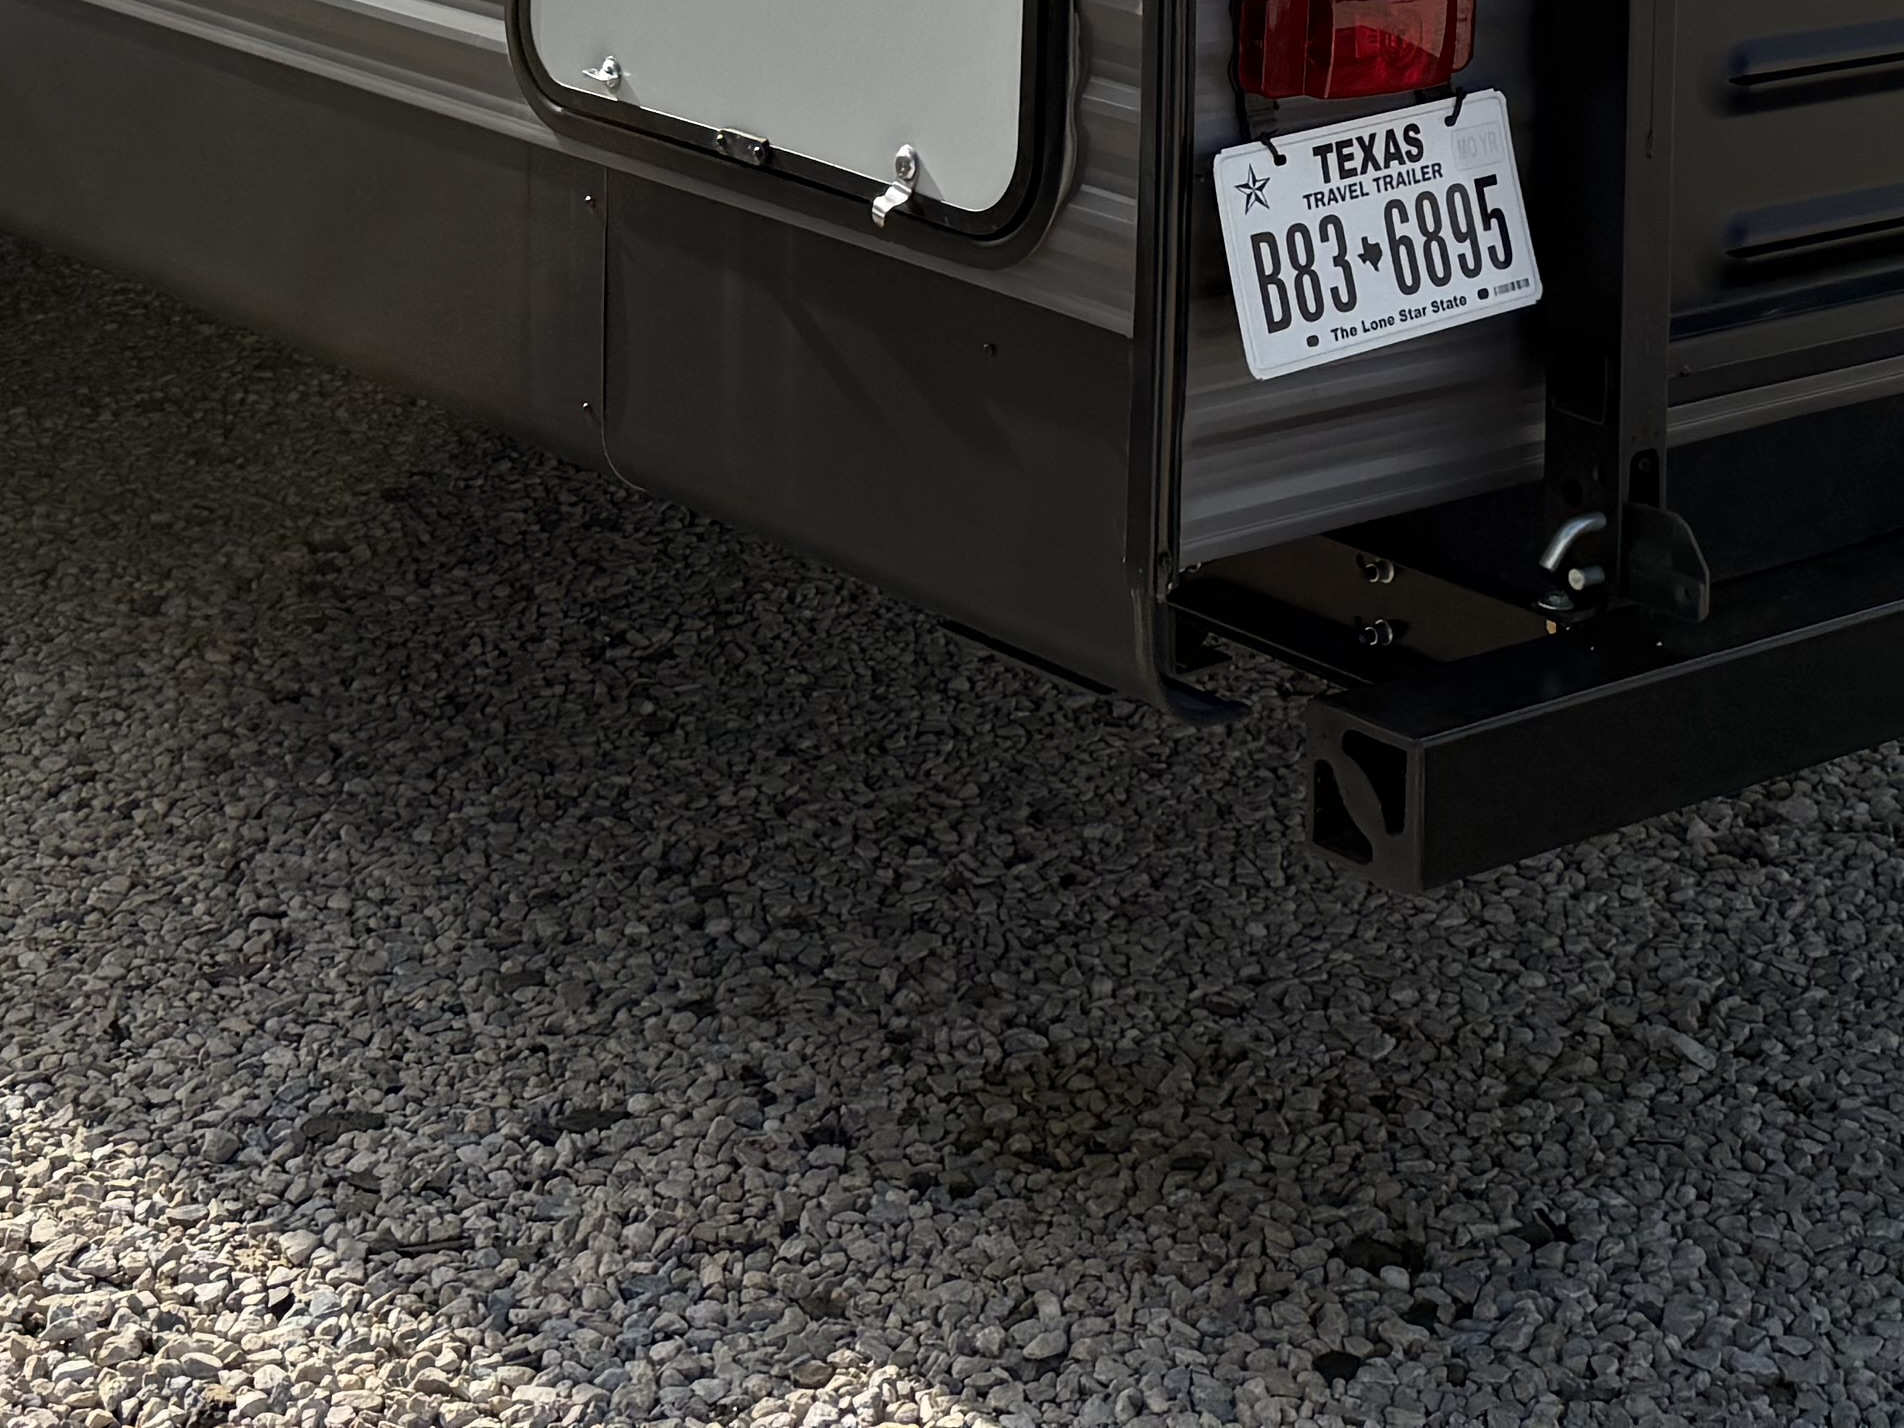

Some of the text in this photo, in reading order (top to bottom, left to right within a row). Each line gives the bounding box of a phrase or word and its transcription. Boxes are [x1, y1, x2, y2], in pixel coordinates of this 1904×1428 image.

[1312, 123, 1424, 184] TEXAS
[1303, 162, 1444, 211] TRAVEL TRAILER
[1330, 295, 1468, 342] The Lone Star State
